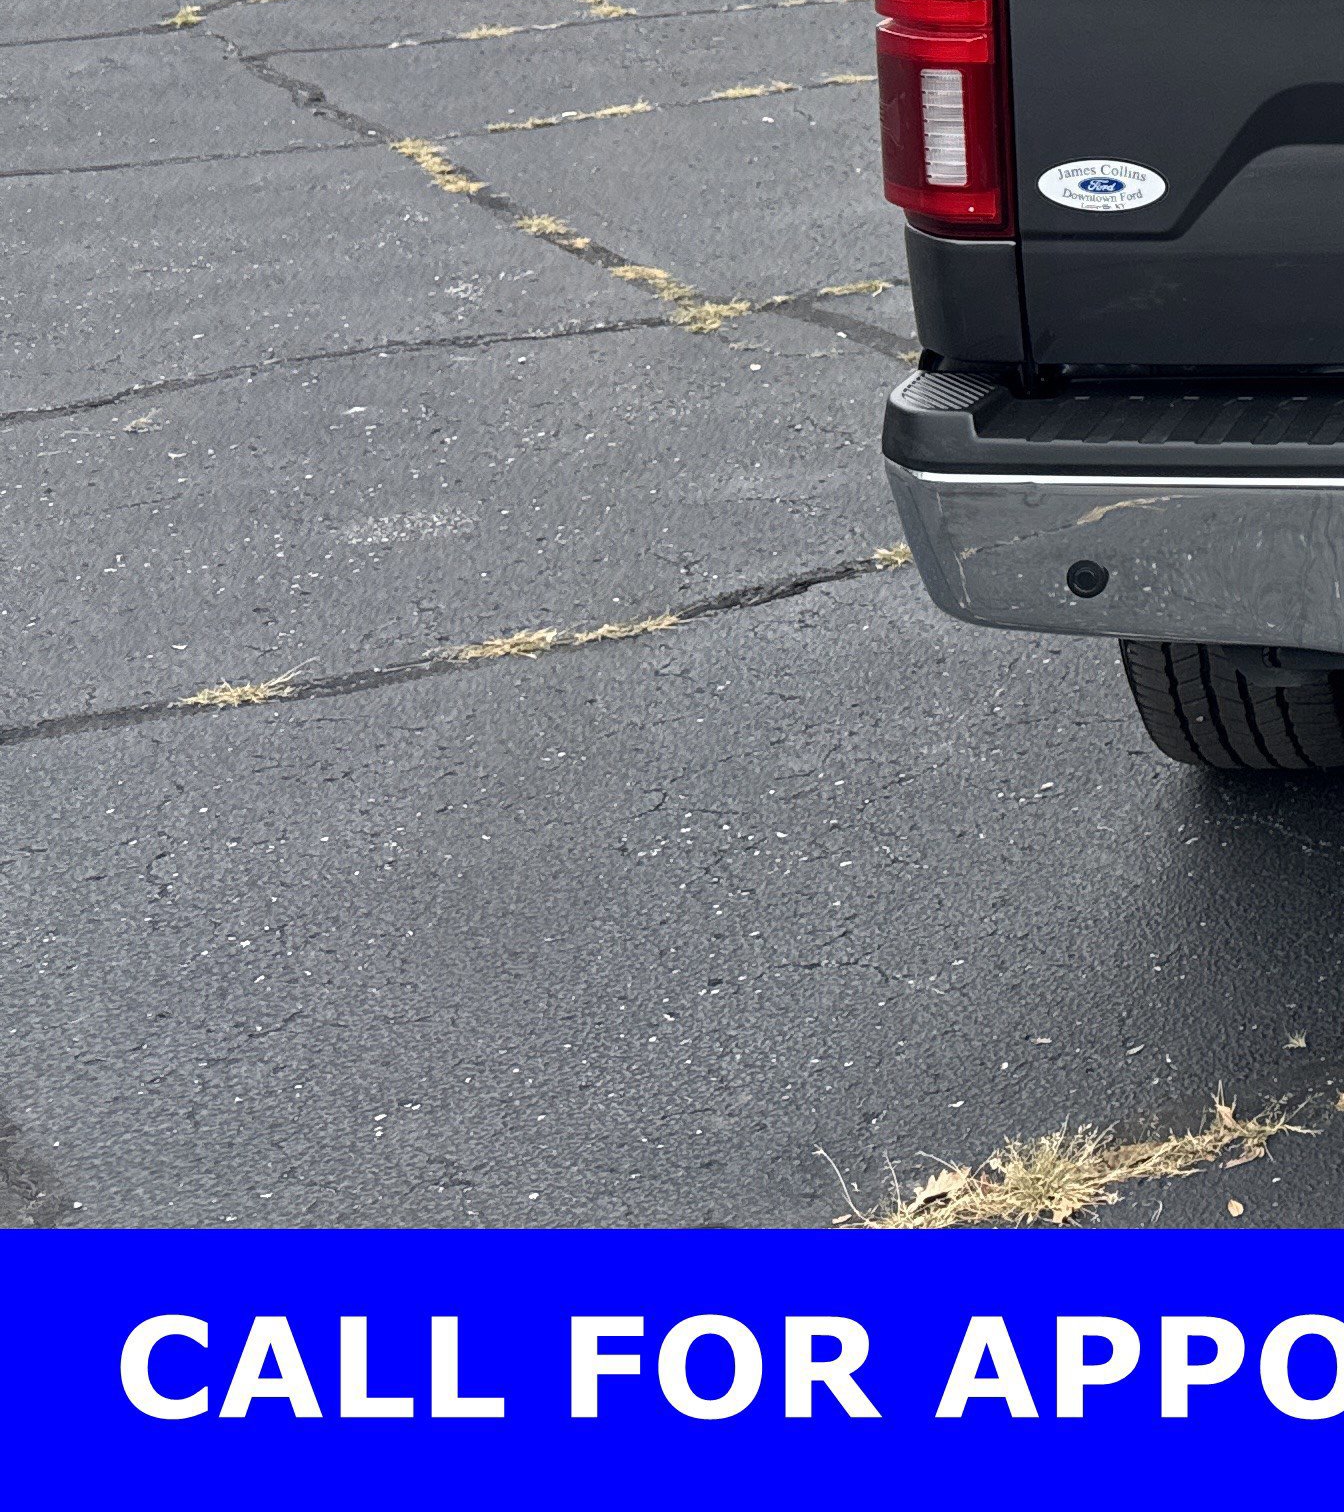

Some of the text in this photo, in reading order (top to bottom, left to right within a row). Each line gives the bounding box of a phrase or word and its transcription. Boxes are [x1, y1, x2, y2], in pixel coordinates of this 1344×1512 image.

[1057, 164, 1147, 182] James Collins
[1087, 179, 1117, 191] Ford
[1062, 188, 1143, 202] Downtown Ford
